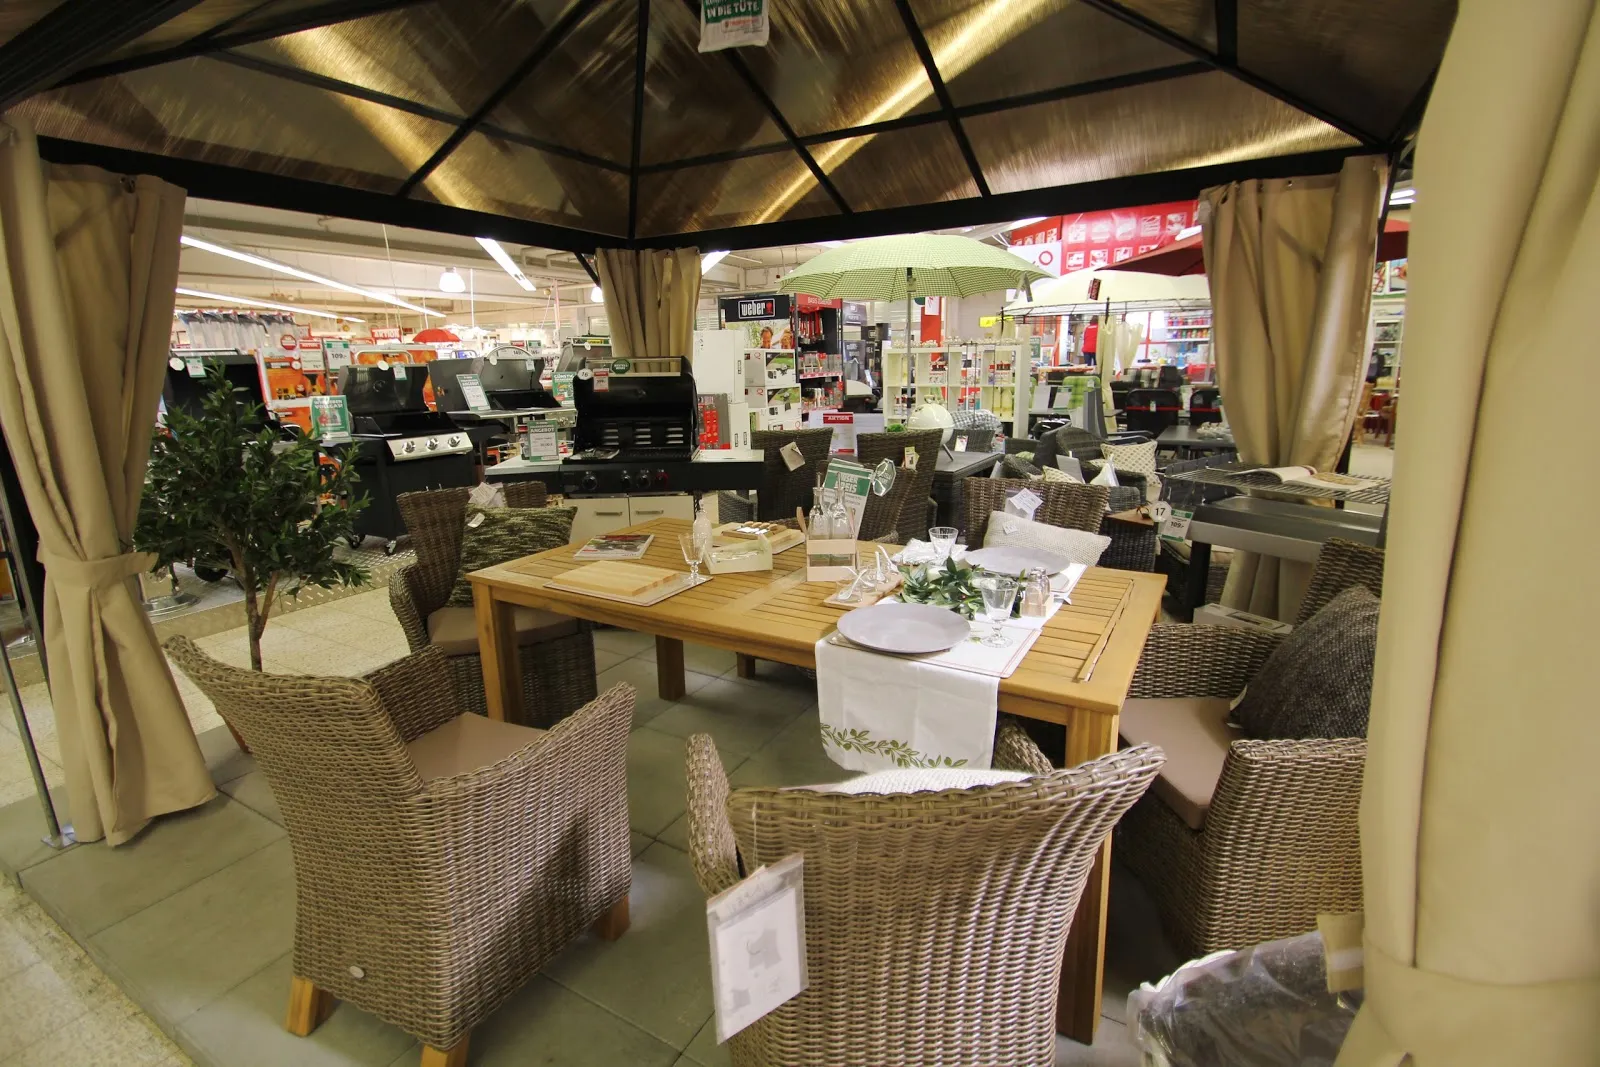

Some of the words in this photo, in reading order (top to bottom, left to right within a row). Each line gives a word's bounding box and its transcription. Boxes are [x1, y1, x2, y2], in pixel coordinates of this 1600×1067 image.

[707, 7, 716, 19] IN
[717, 4, 732, 16] DIE
[741, 300, 766, 316] weber
[1155, 507, 1166, 516] 17
